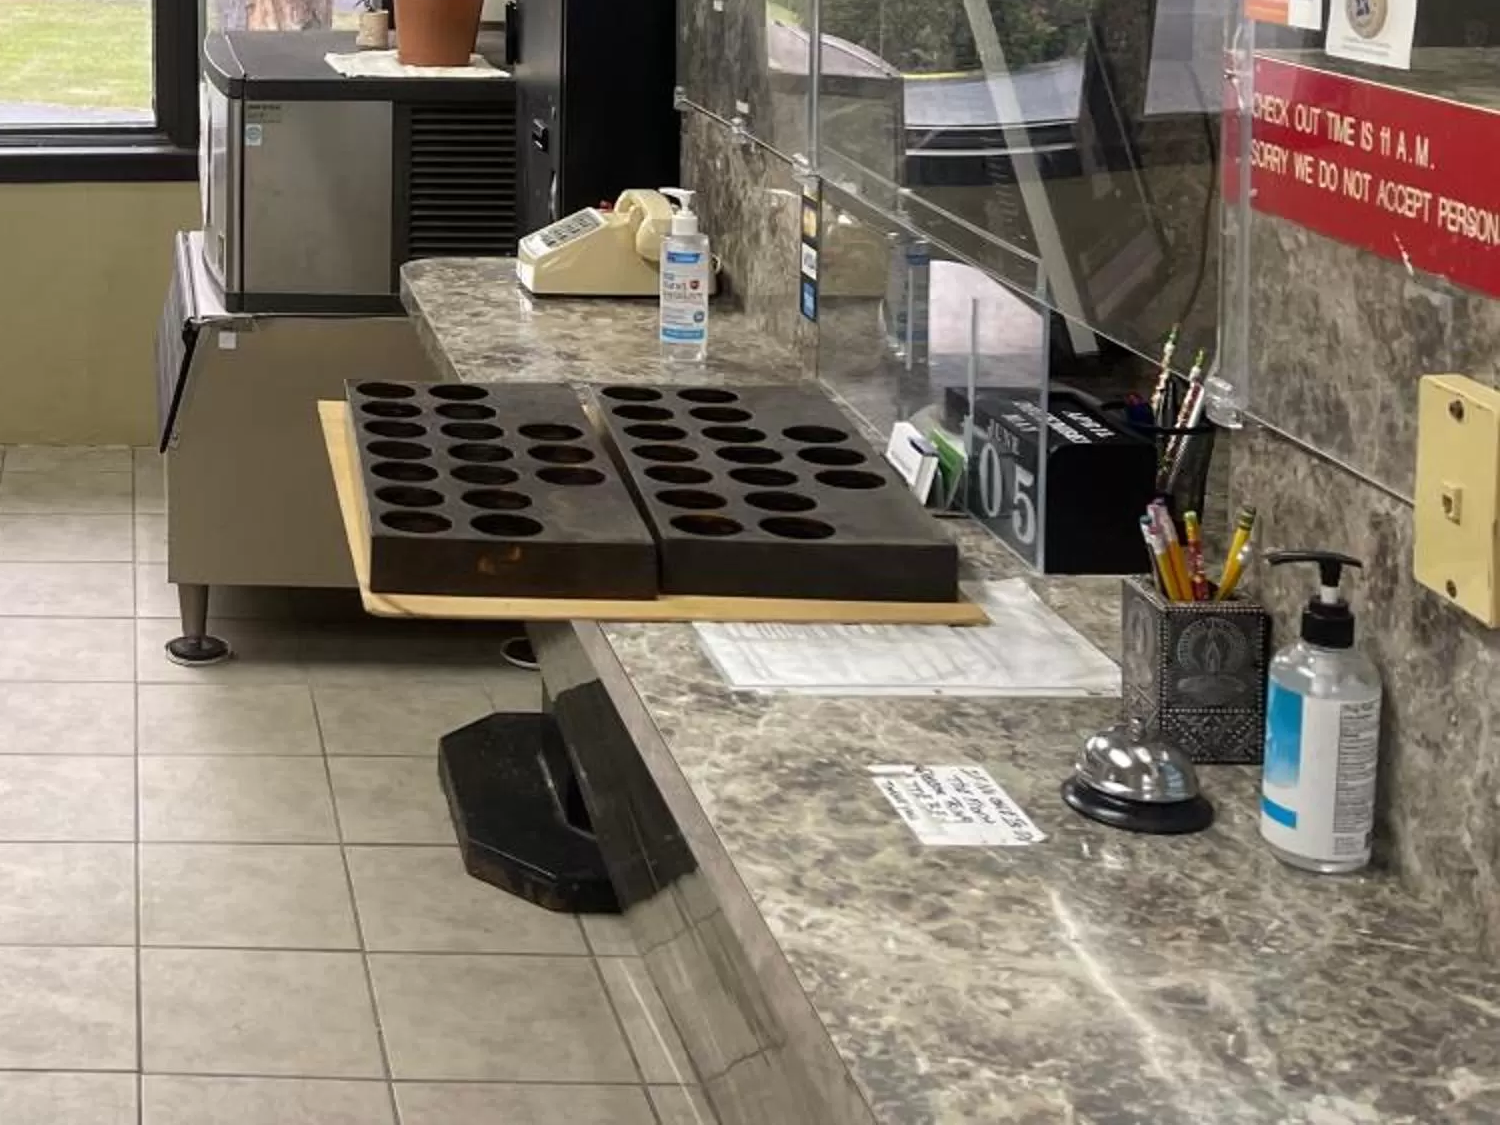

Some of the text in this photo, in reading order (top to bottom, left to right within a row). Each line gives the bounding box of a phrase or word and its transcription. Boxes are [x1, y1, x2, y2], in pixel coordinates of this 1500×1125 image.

[1251, 92, 1290, 128] CHECK
[1295, 103, 1322, 136] OUT
[1326, 110, 1356, 147] TIME
[1360, 120, 1375, 152] IS
[1380, 125, 1391, 156] 11
[1250, 138, 1500, 247] SORRY WE DO NOT ACCEPT PERSON
[979, 442, 1036, 545] 05
